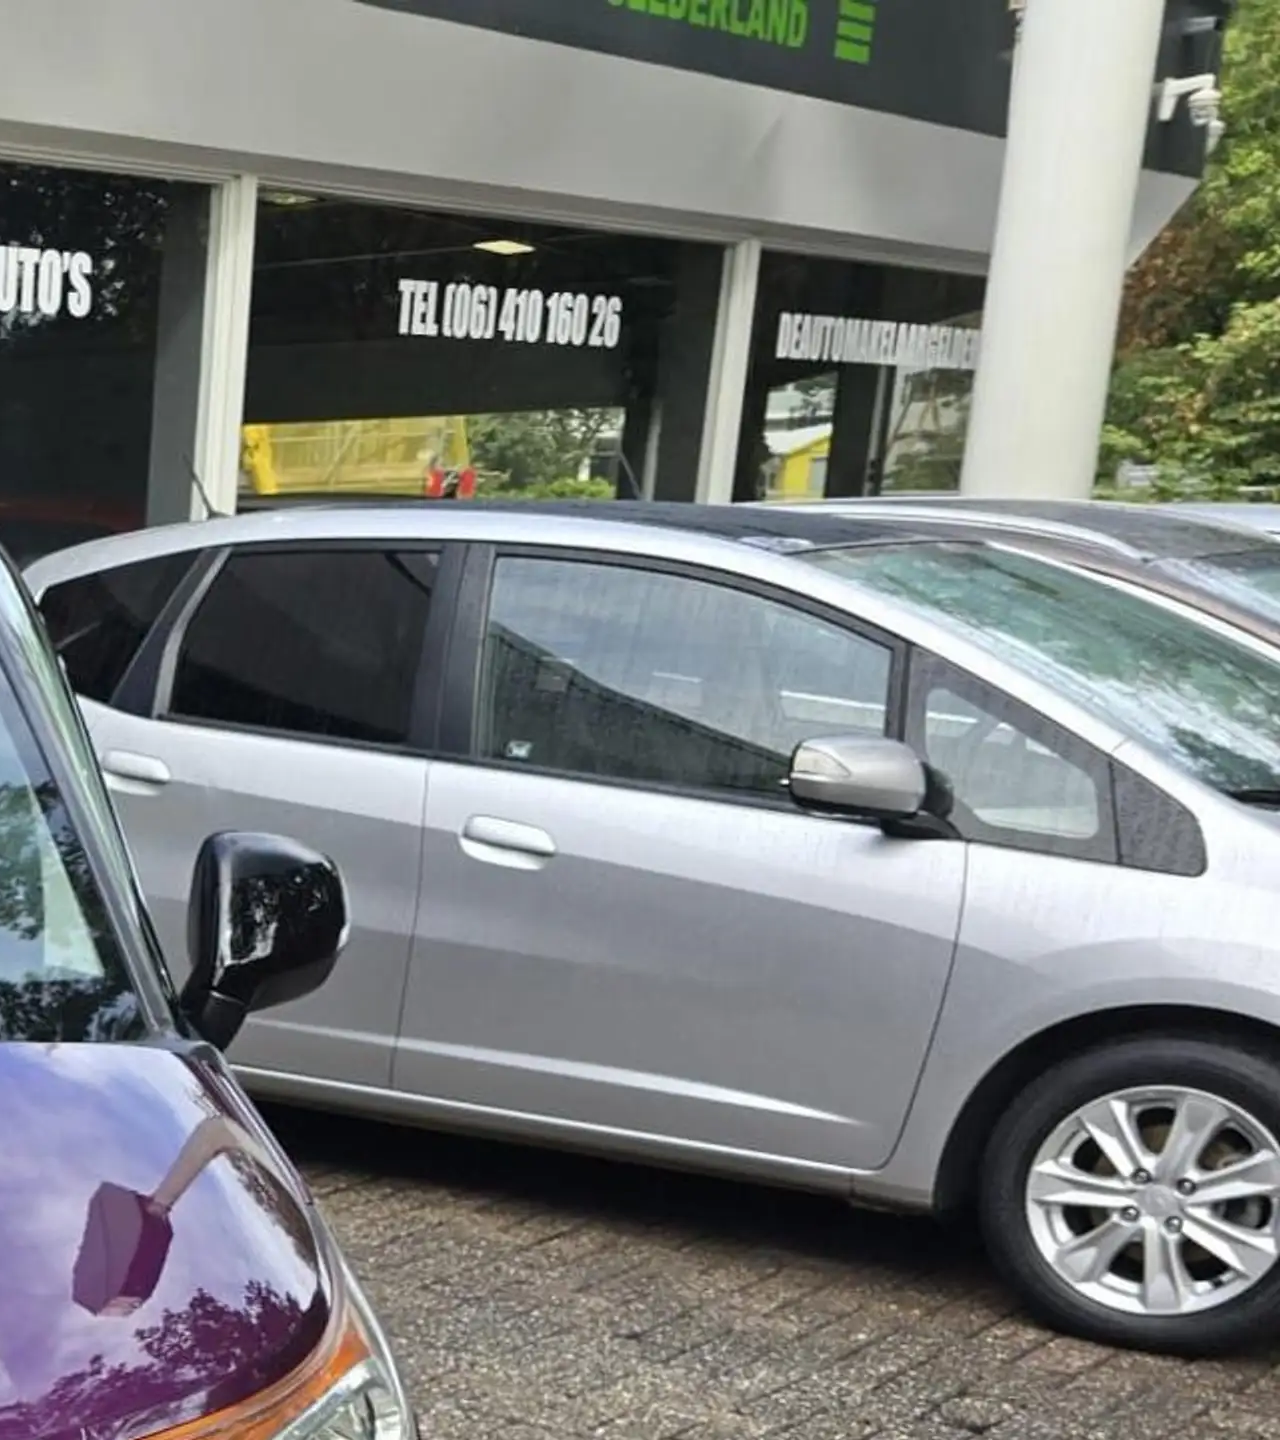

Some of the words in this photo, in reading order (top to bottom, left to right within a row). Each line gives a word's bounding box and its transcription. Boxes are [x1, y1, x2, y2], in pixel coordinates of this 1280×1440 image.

[398, 278, 439, 337] TEL
[442, 283, 498, 340] (06)
[498, 288, 544, 344] 410
[546, 292, 590, 347] 160
[588, 295, 623, 349] 26
